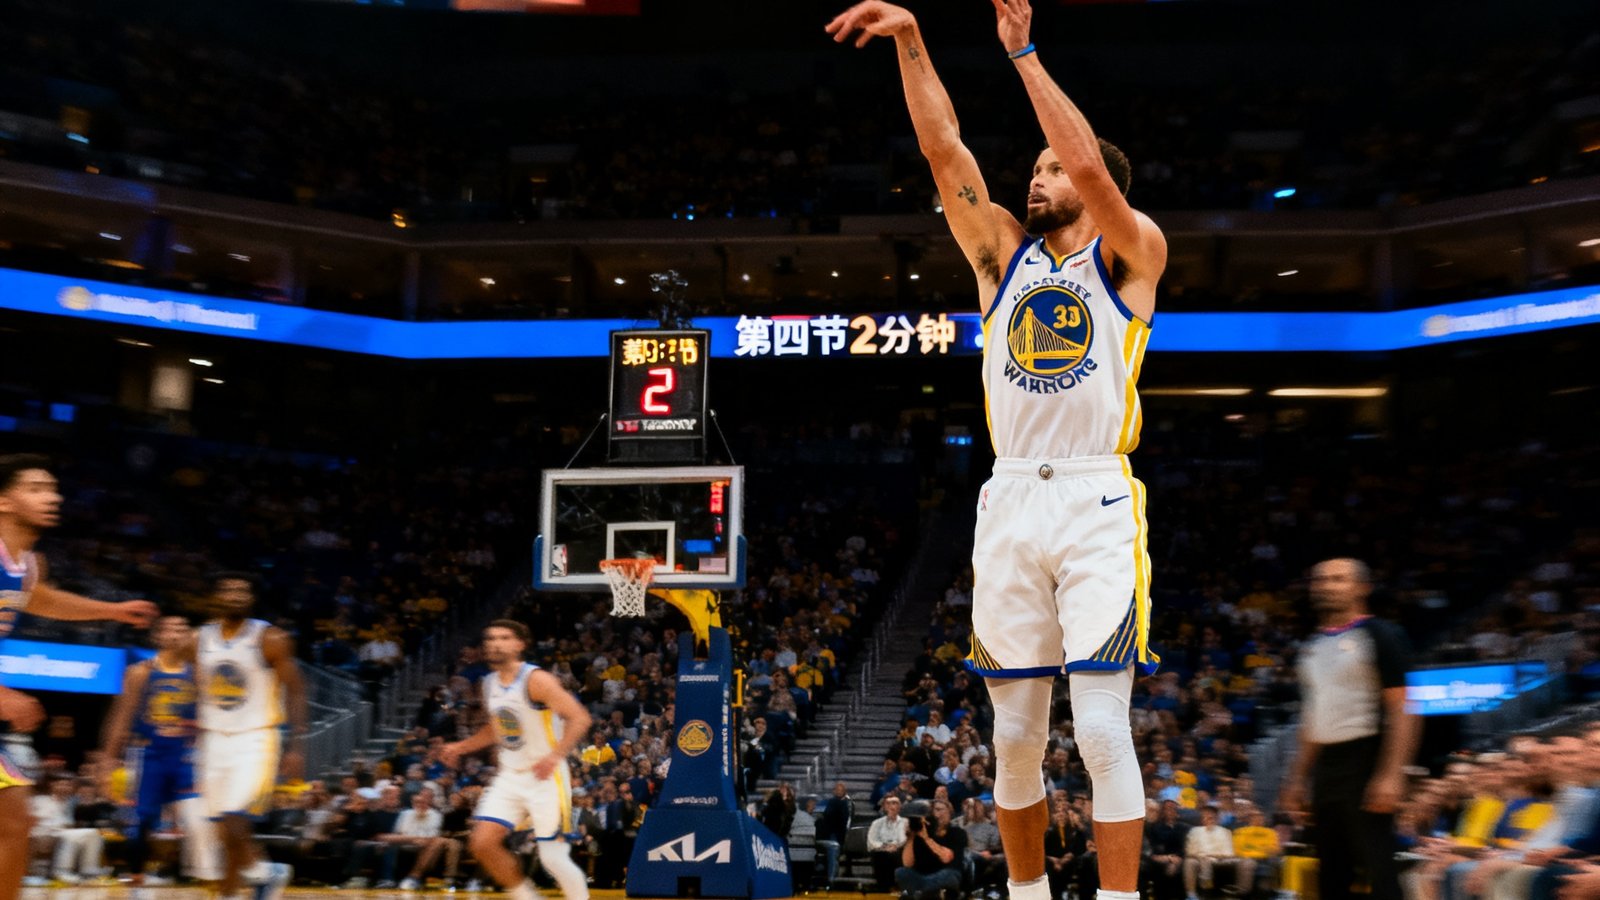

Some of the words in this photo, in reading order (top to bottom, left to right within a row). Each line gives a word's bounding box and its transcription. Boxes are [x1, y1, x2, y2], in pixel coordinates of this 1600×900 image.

[735, 314, 956, 356] 第四节2分钟
[643, 367, 674, 413] 2
